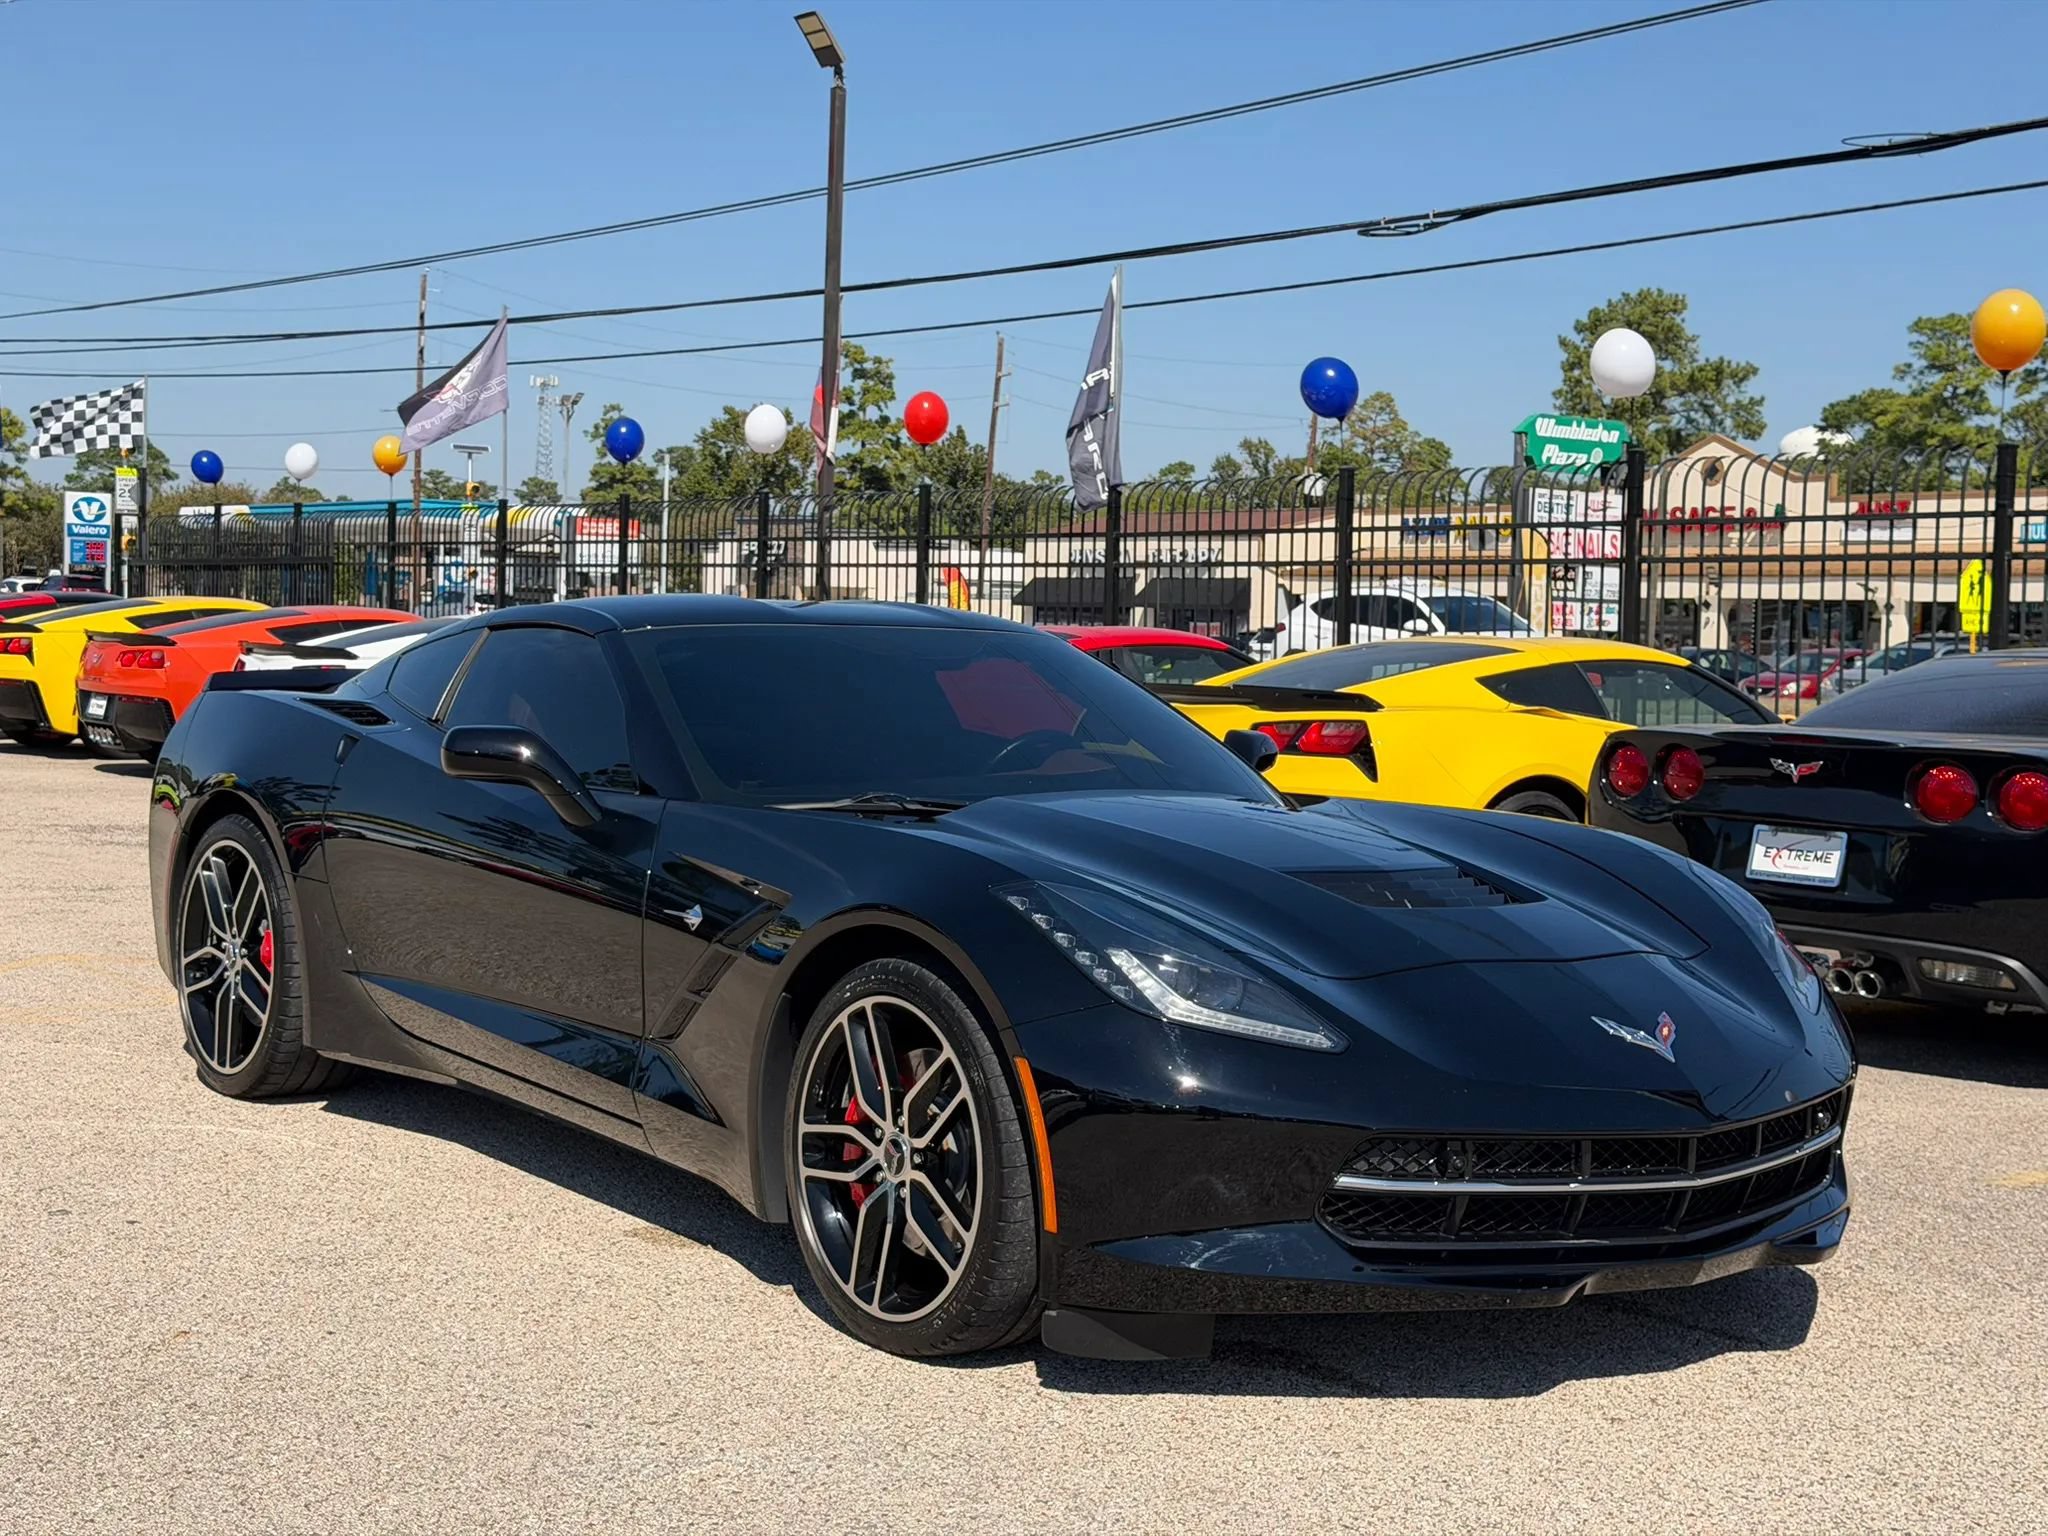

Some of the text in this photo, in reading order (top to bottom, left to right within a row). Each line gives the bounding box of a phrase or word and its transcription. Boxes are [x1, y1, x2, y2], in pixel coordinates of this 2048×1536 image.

[1535, 417, 1620, 443] Wimbledon
[1542, 444, 1589, 467] Plaza
[72, 524, 107, 535] Valero
[1455, 515, 1513, 536] NAIS
[1763, 846, 1834, 865] EXTREME
